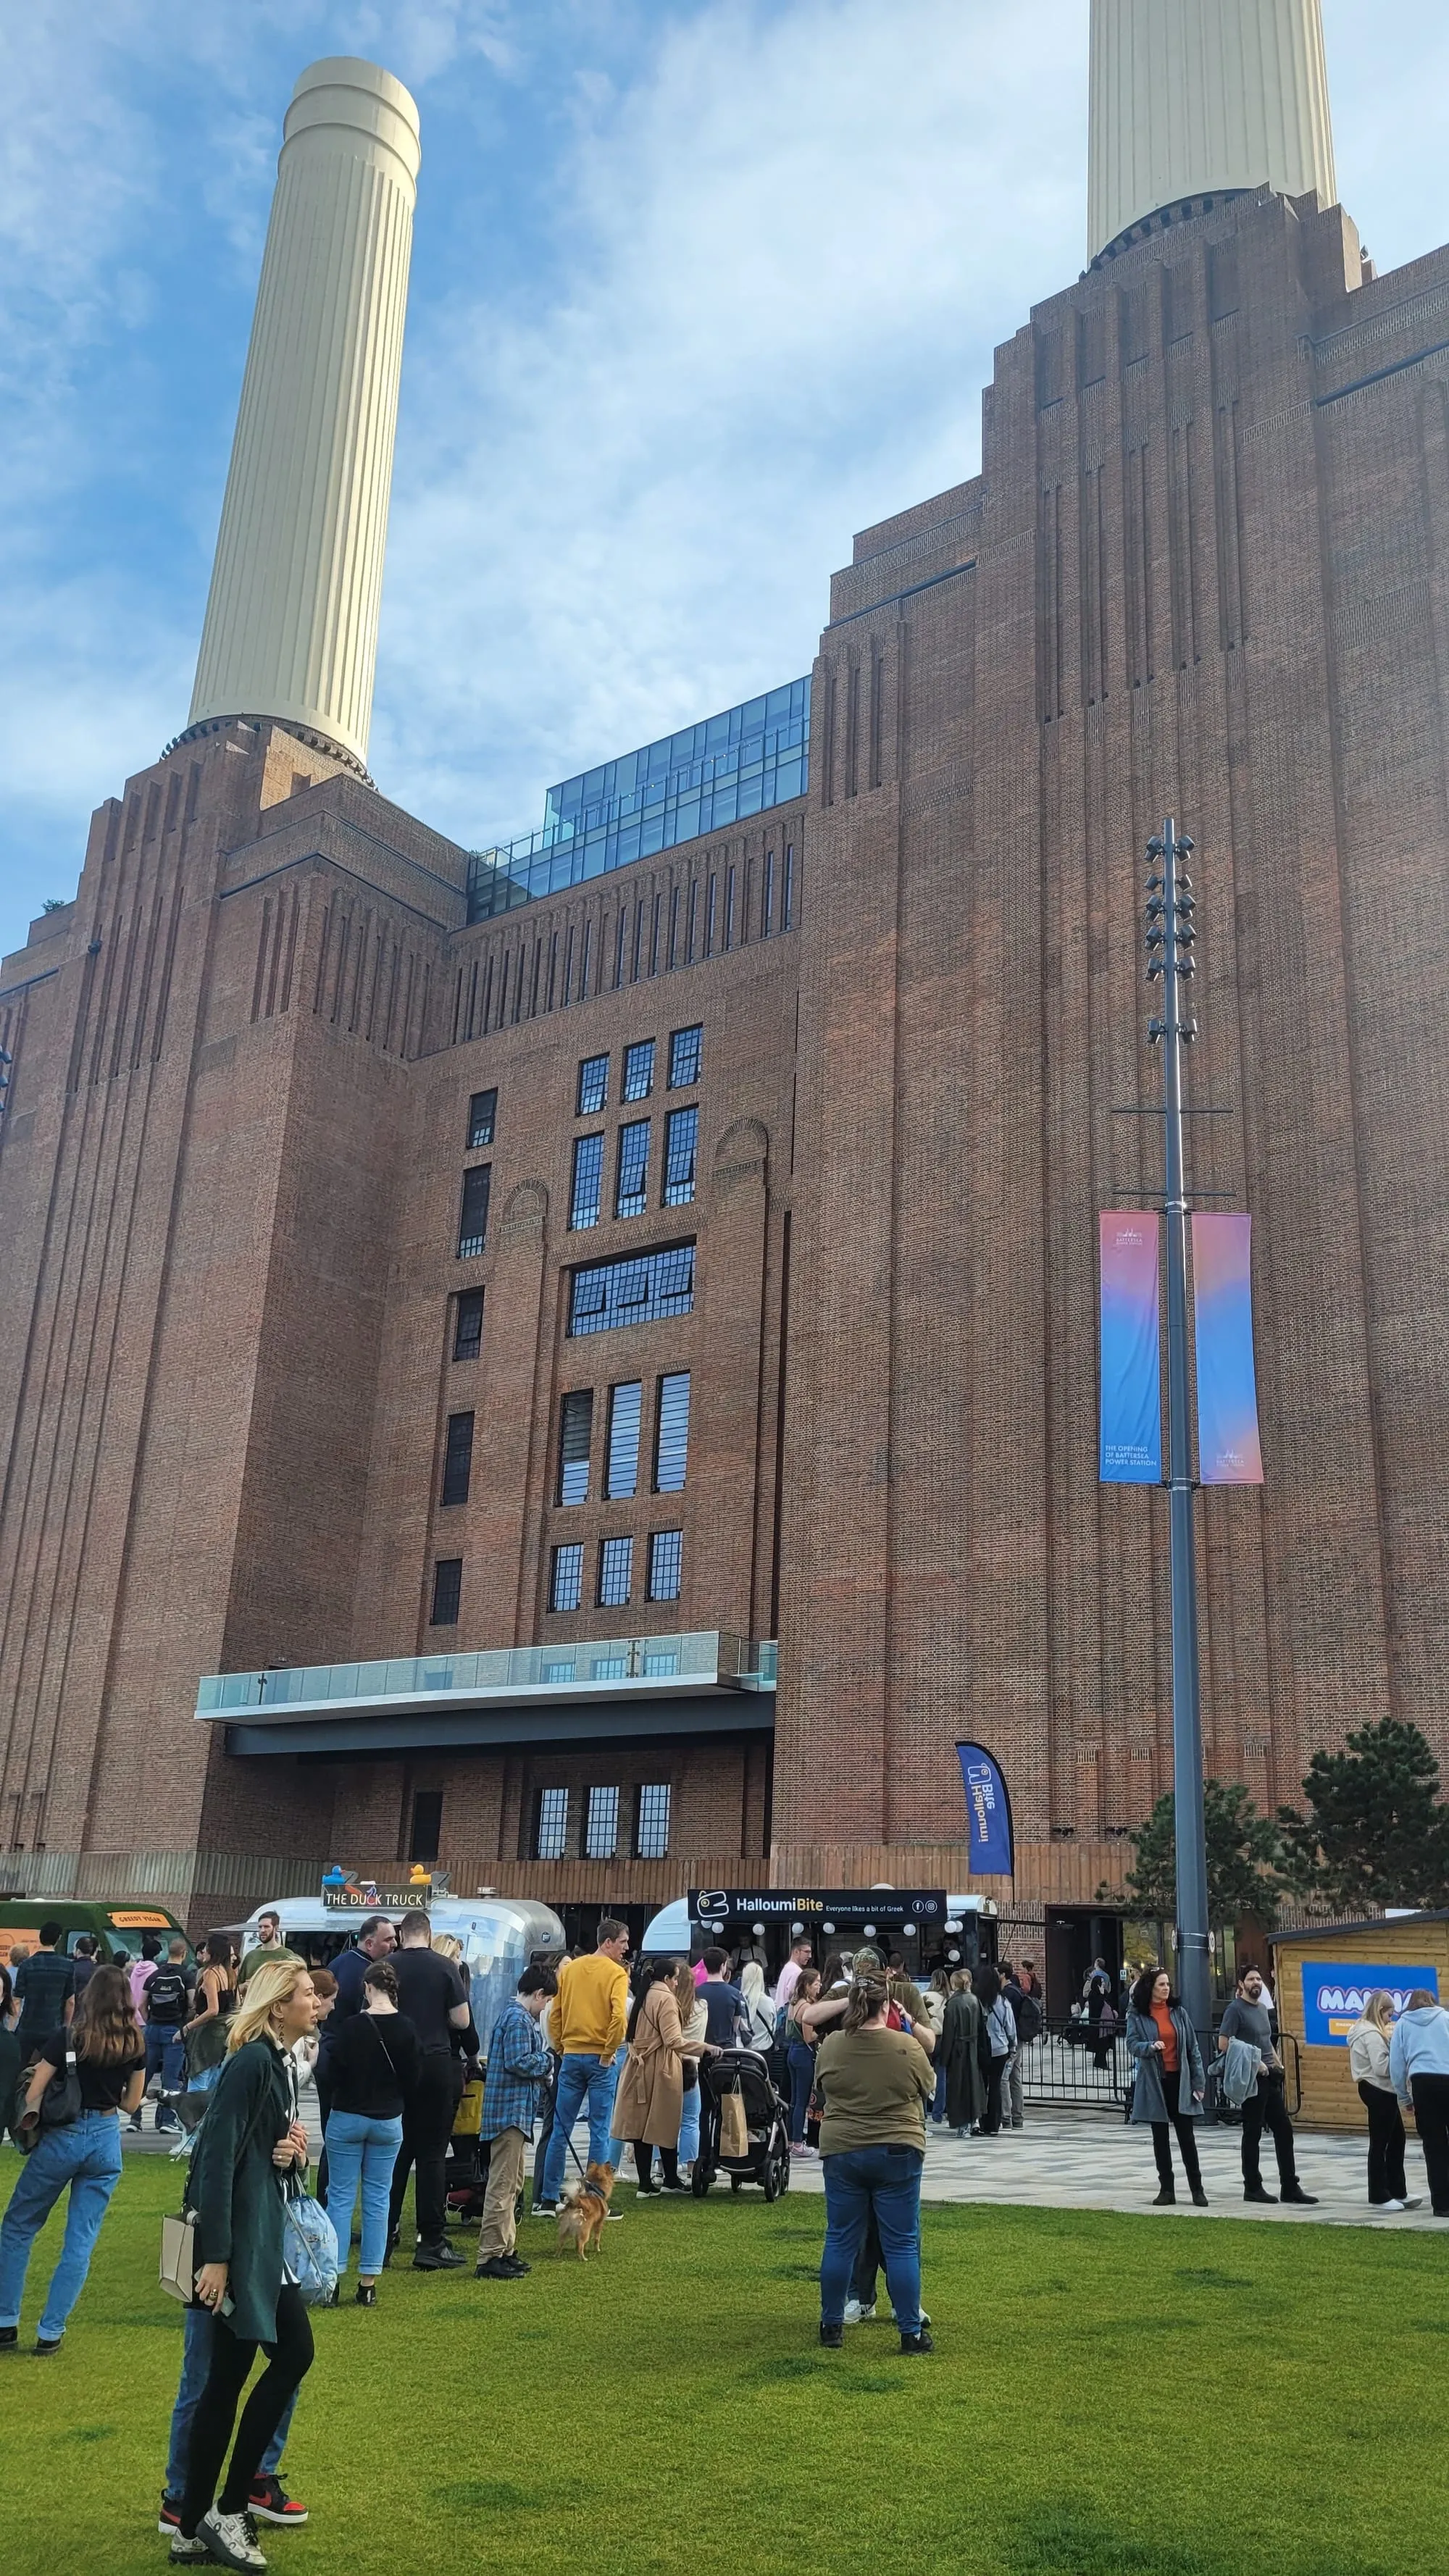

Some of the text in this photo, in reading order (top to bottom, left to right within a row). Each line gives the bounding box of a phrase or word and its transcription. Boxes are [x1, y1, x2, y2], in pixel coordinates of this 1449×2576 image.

[326, 1888, 423, 1906] THE DUCK TRUCK
[736, 1897, 824, 1911] HalloumiBite
